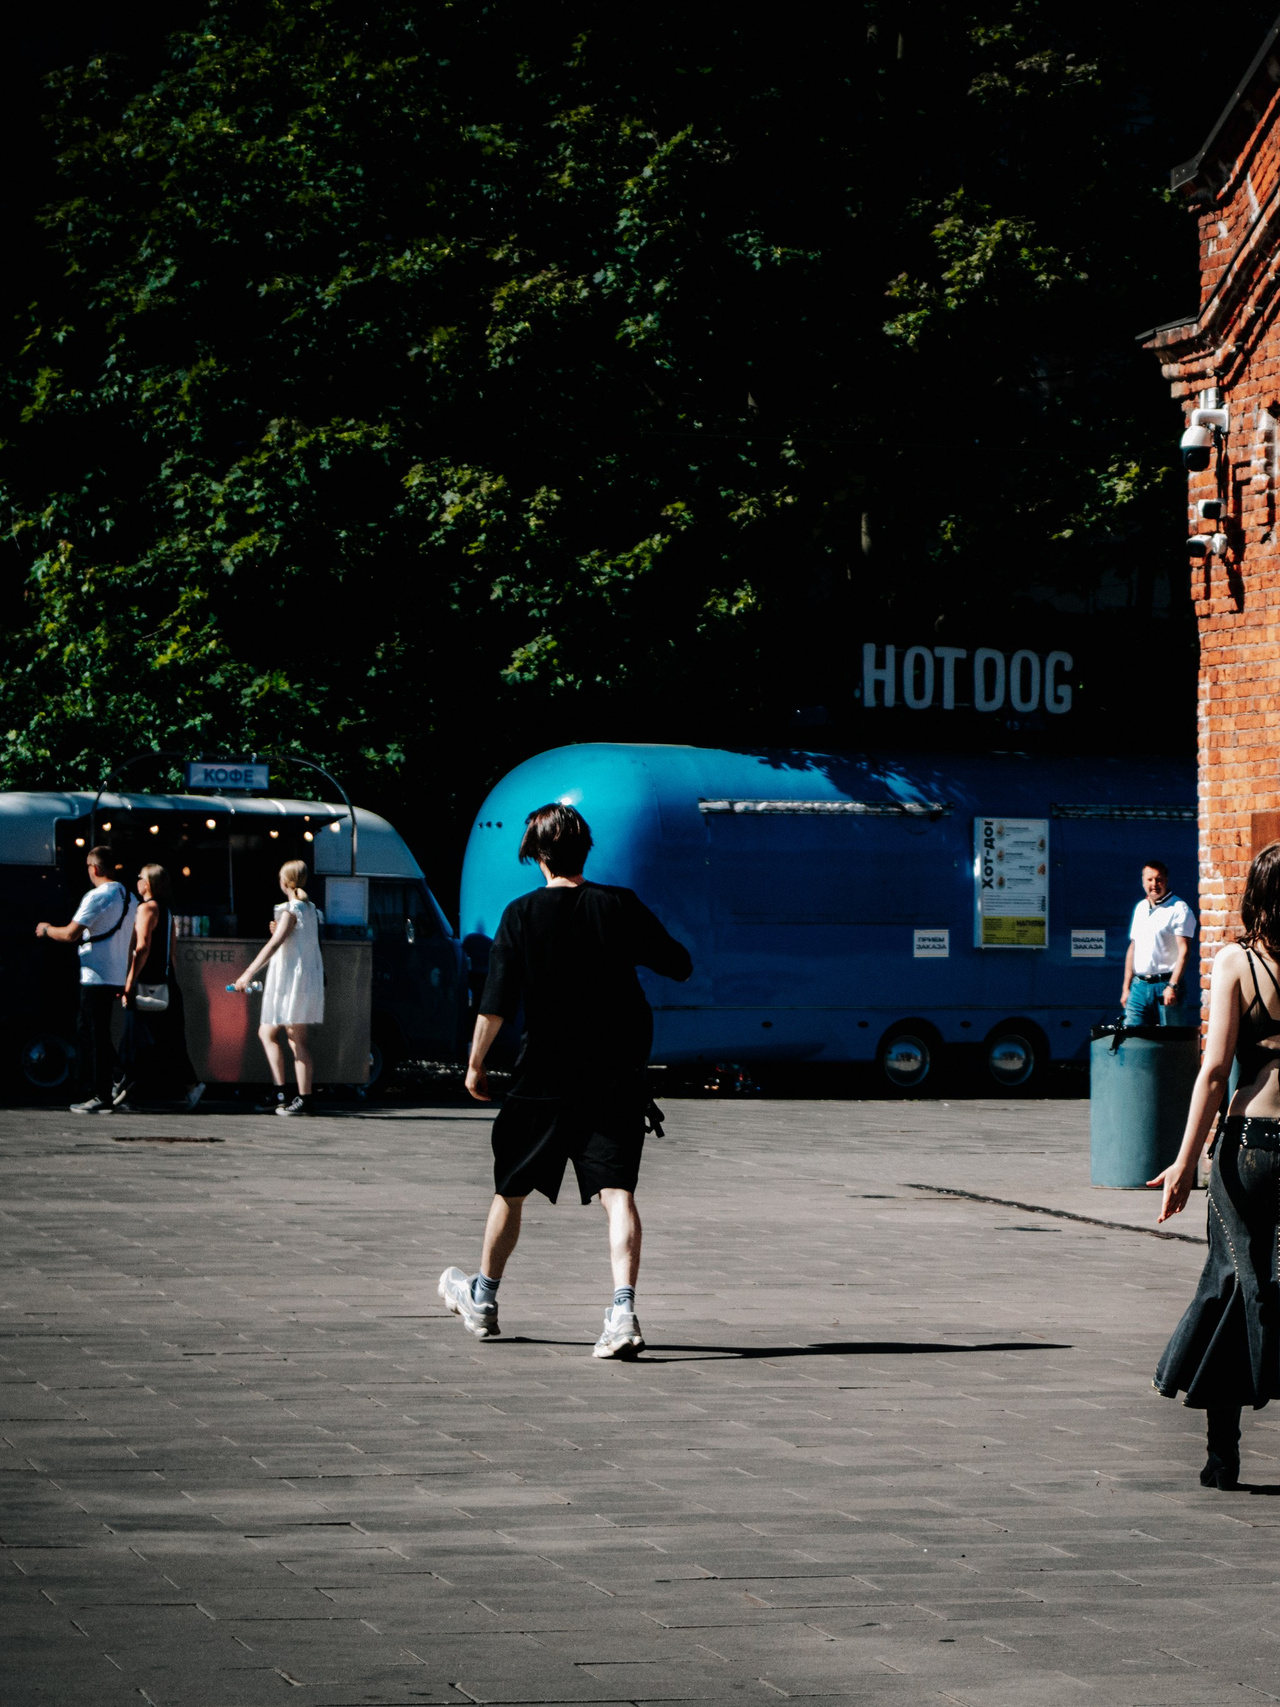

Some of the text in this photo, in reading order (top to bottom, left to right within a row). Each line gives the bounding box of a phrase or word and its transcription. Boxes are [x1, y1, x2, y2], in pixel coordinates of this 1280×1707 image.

[862, 642, 1074, 714] HOT DOG
[203, 768, 254, 783] КОФЕ
[184, 949, 236, 962] COFFEE
